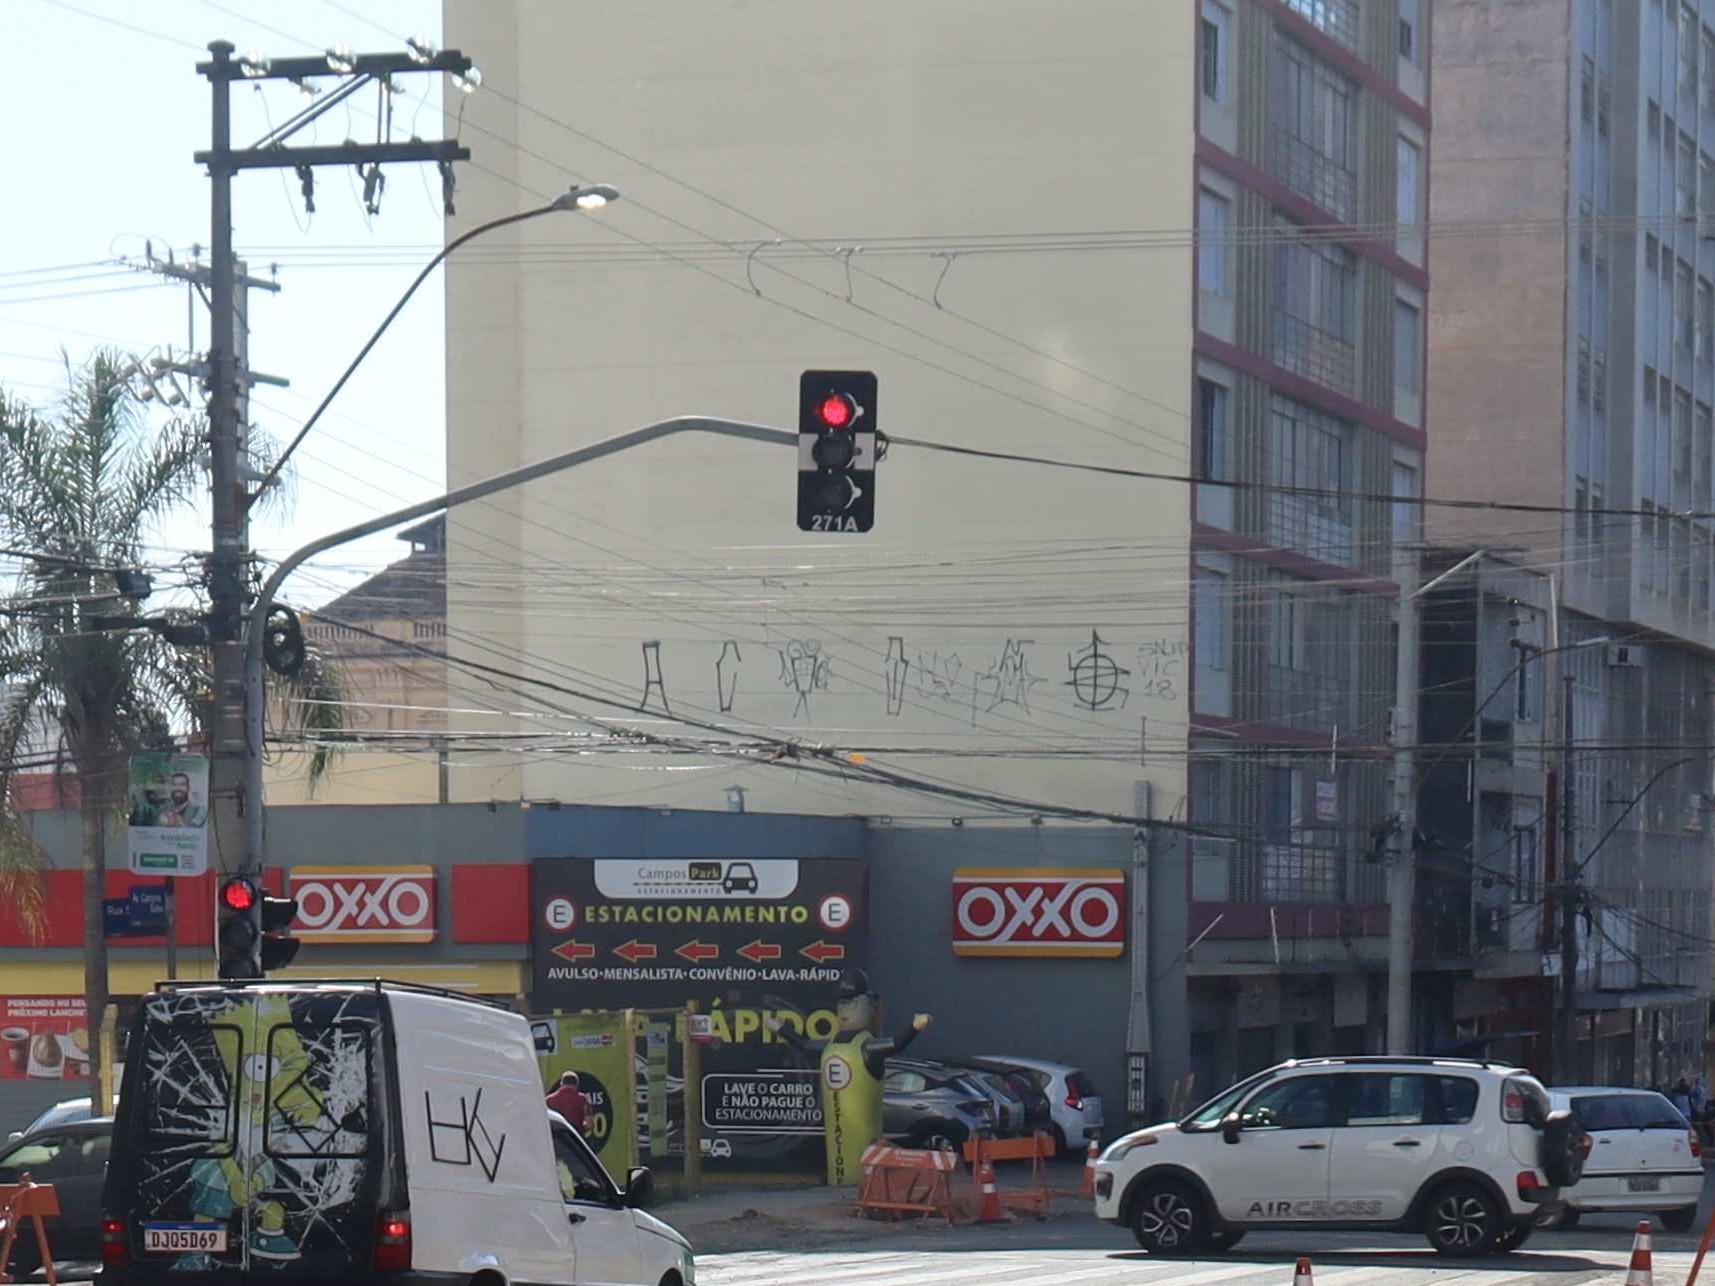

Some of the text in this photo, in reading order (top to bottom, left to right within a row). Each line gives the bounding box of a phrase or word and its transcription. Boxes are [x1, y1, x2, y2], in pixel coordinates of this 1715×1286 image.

[811, 514, 858, 531] 271A
[637, 865, 720, 881] Campos Park
[291, 880, 431, 928] OXXO
[585, 904, 809, 924] ESTACIONAMENTO
[957, 884, 1119, 941] OXXO
[547, 965, 840, 982] AVULSO MENSALISTA CONVÊNIO LAVA-RÁPID
[50, 1008, 86, 1017] LANCHE
[724, 1083, 757, 1095] LAVE
[771, 1083, 813, 1095] CARRO
[732, 1093, 760, 1108] NÃO
[762, 1096, 803, 1109] PAGUE
[716, 1108, 823, 1121] ESTACIONAMENTO
[1245, 1200, 1383, 1217] AIRCROSS
[151, 1232, 218, 1248] DJQ5D69
